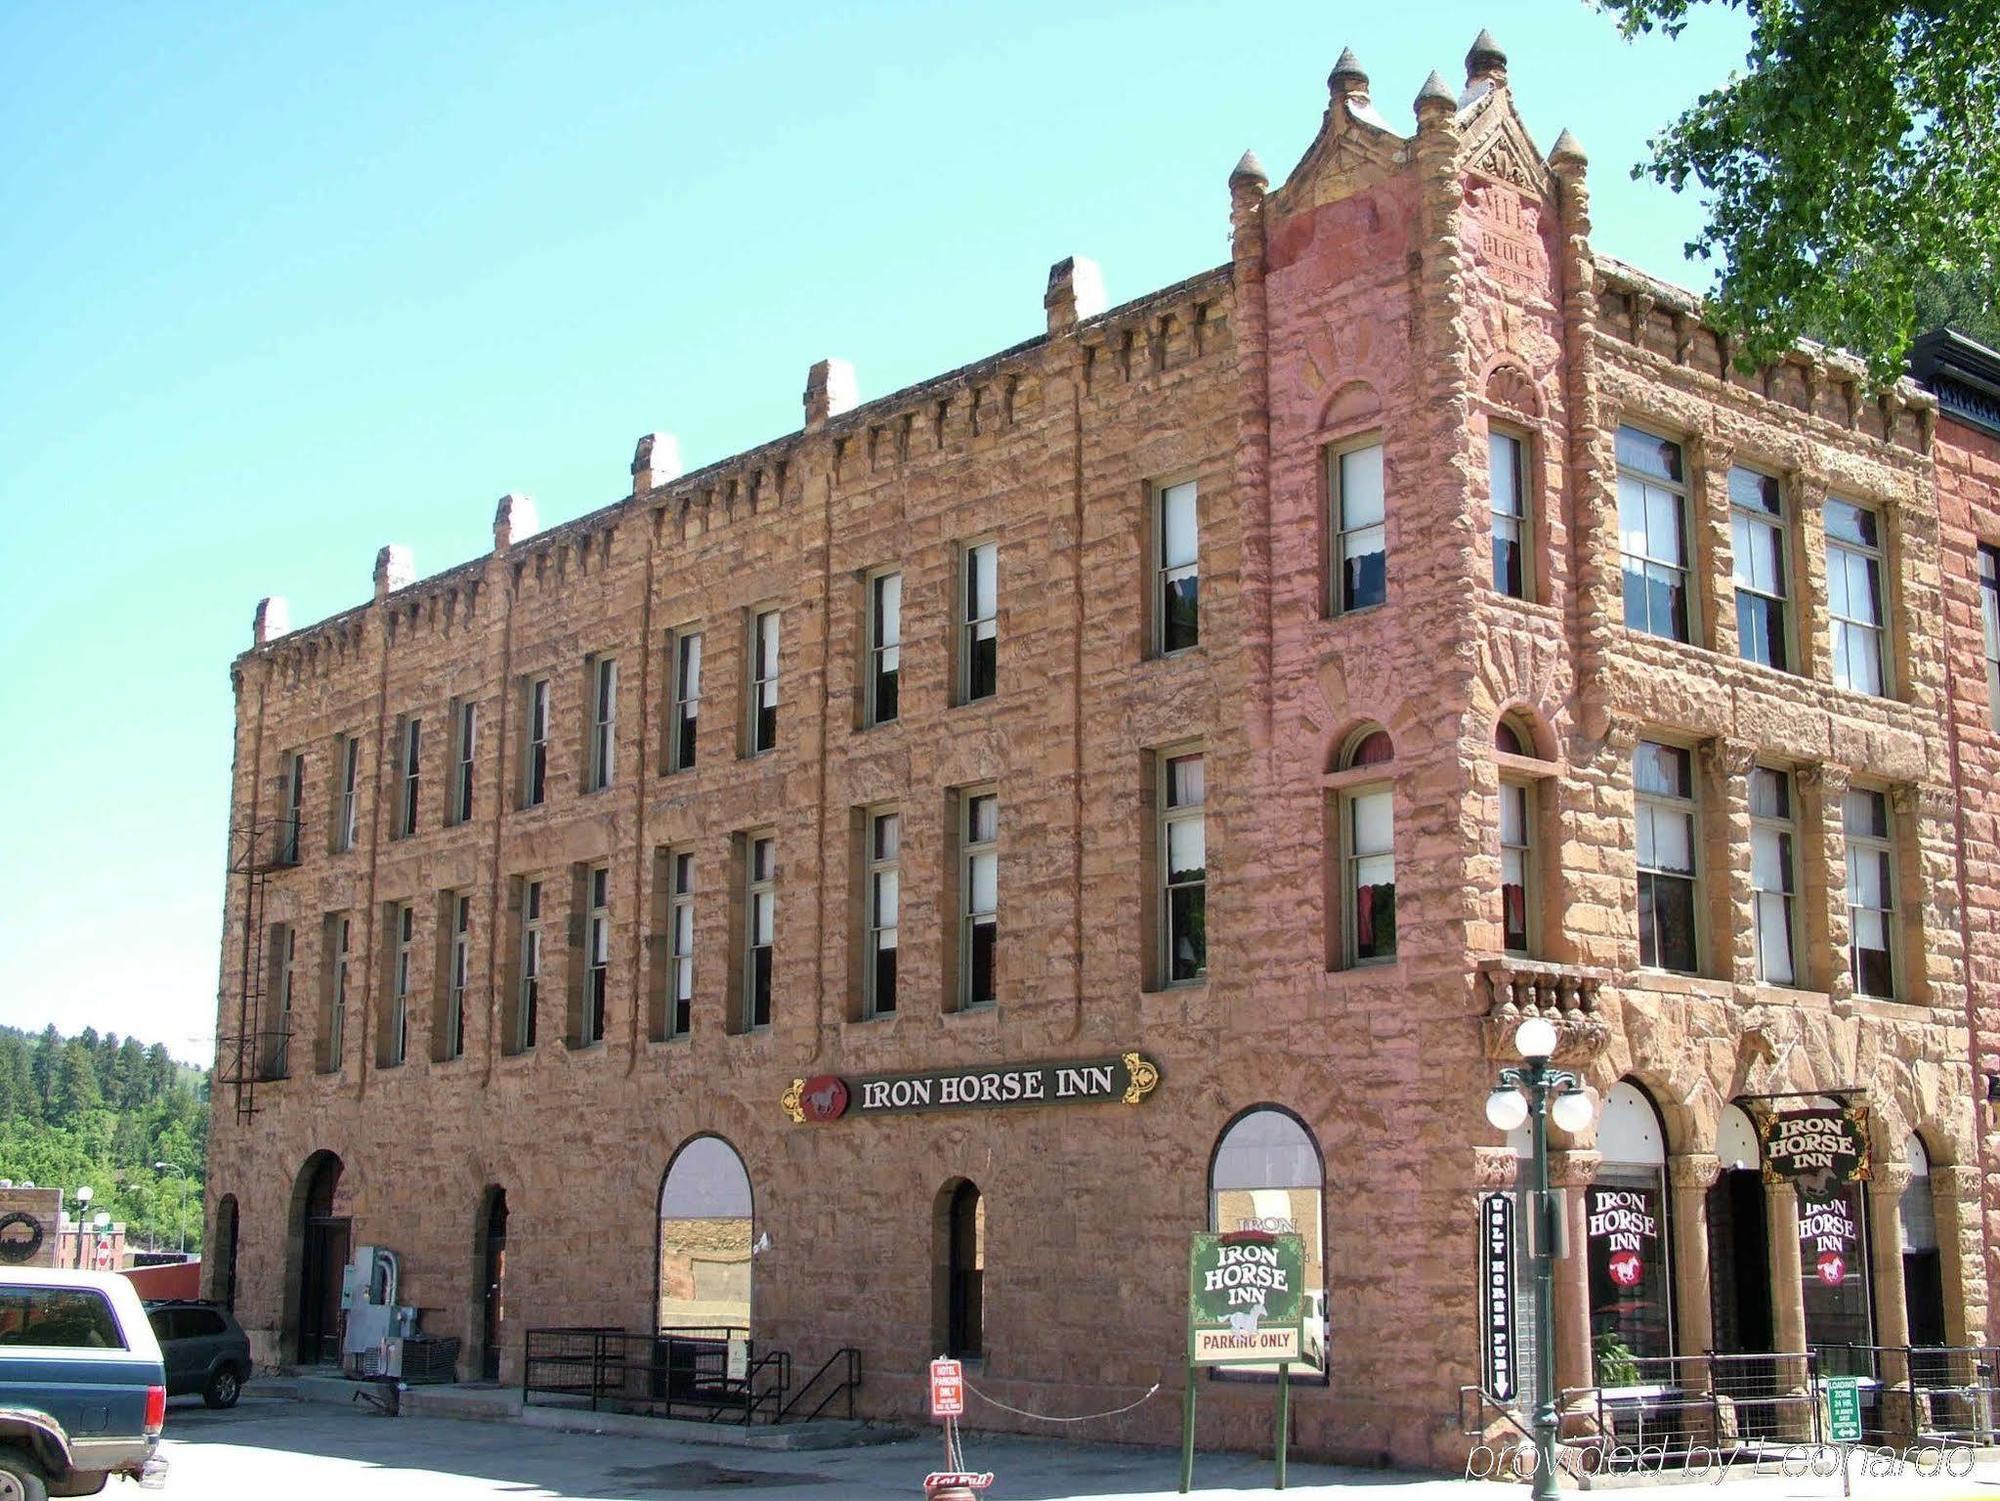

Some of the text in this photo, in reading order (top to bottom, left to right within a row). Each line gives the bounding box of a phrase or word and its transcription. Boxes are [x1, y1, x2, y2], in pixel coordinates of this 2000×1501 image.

[863, 1066, 1114, 1109] IRON HORSE INN
[1779, 1118, 1843, 1138] IRON
[1768, 1133, 1856, 1158] HORSE
[1792, 1152, 1833, 1168] INN
[1595, 1192, 1645, 1212] IRON
[1491, 1199, 1505, 1253] UGLY
[1589, 1208, 1657, 1238] HORSE
[1799, 1213, 1857, 1240] HORSE
[1609, 1231, 1640, 1252] INN
[1816, 1235, 1843, 1252] INN
[1217, 1245, 1279, 1267] IRON
[1204, 1263, 1288, 1292] HORSE
[1228, 1287, 1267, 1306] INN
[1492, 1261, 1506, 1326] HORSE
[1203, 1333, 1290, 1350] PARKING ONLY
[1829, 1381, 1855, 1389] LOADING
